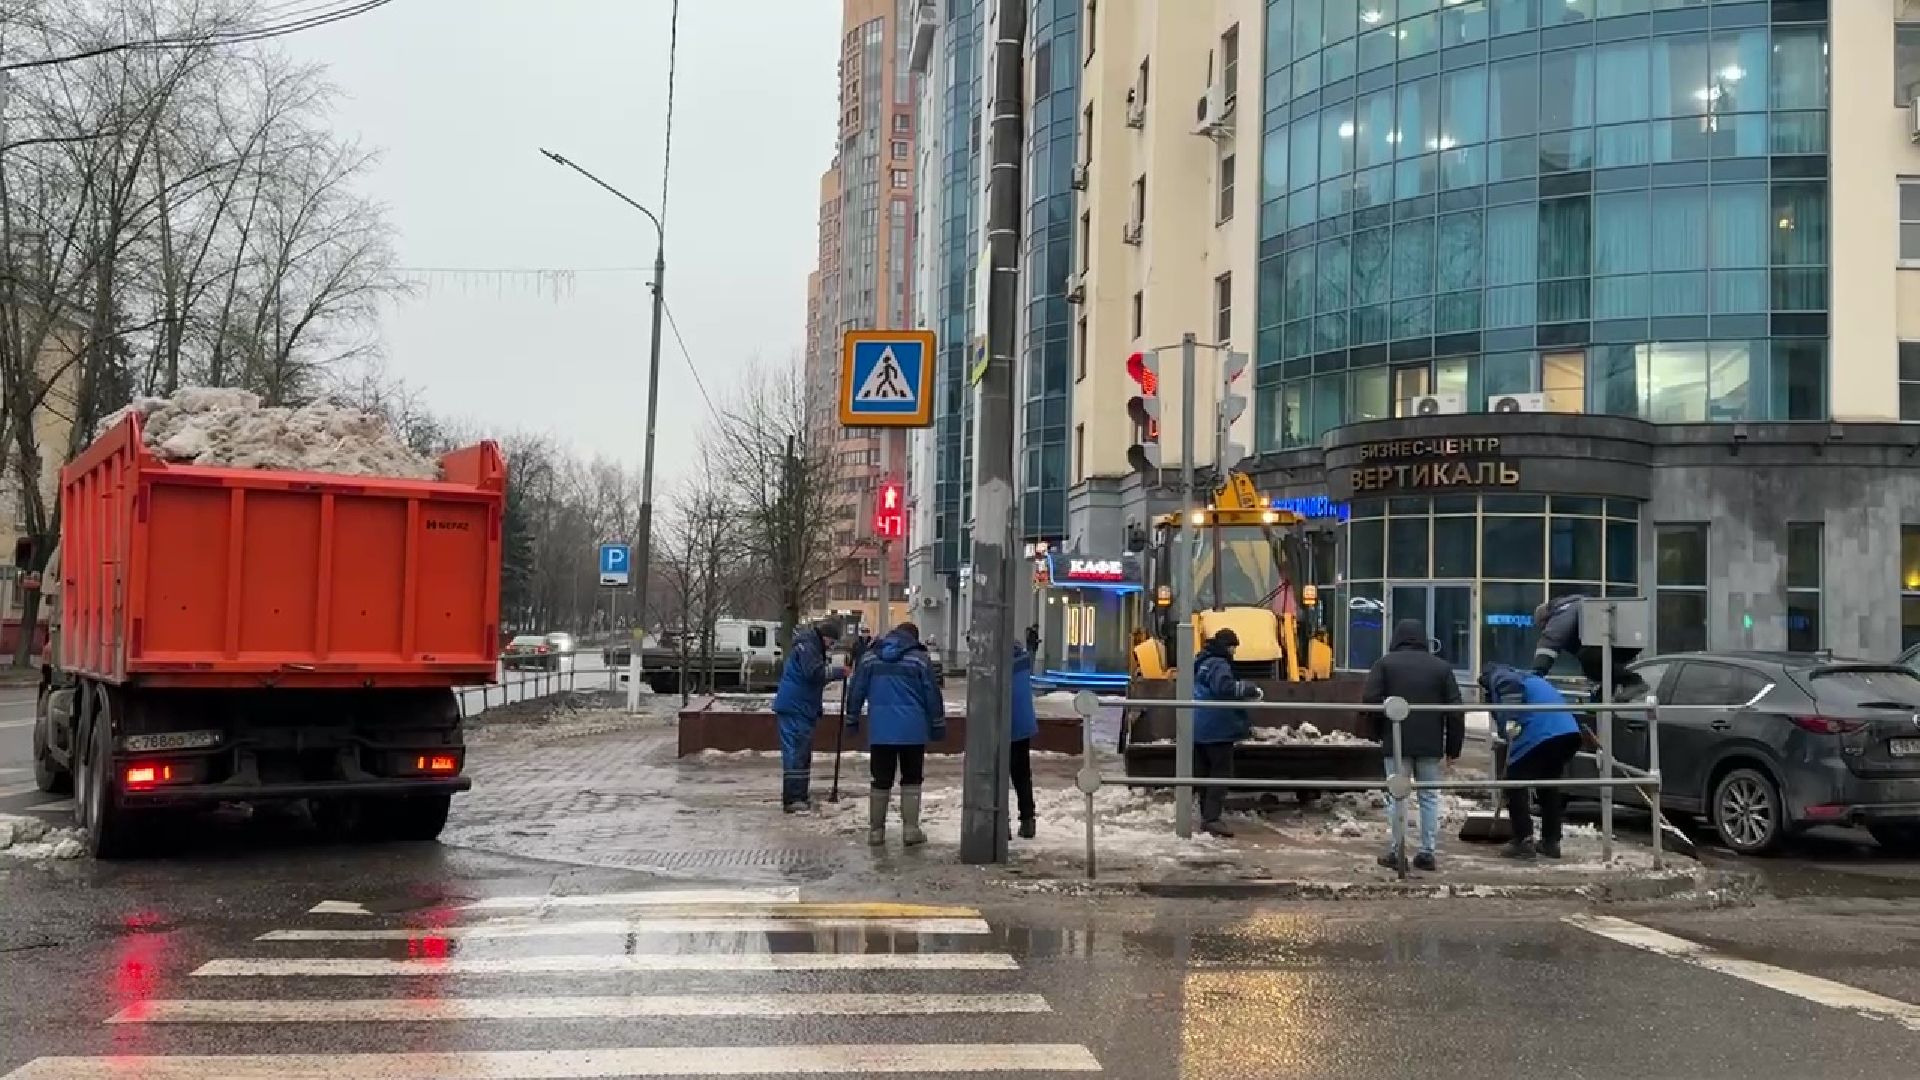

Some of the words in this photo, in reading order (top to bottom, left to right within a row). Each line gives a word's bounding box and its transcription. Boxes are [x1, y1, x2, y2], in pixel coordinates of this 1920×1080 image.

[1359, 437, 1500, 461] БИЗНЕС-ЦЕНТР
[1350, 461, 1520, 491] ВЕРТИКАЛЬ
[877, 515, 901, 536] 47
[608, 548, 625, 570] P
[1070, 560, 1123, 574] КАФЕ
